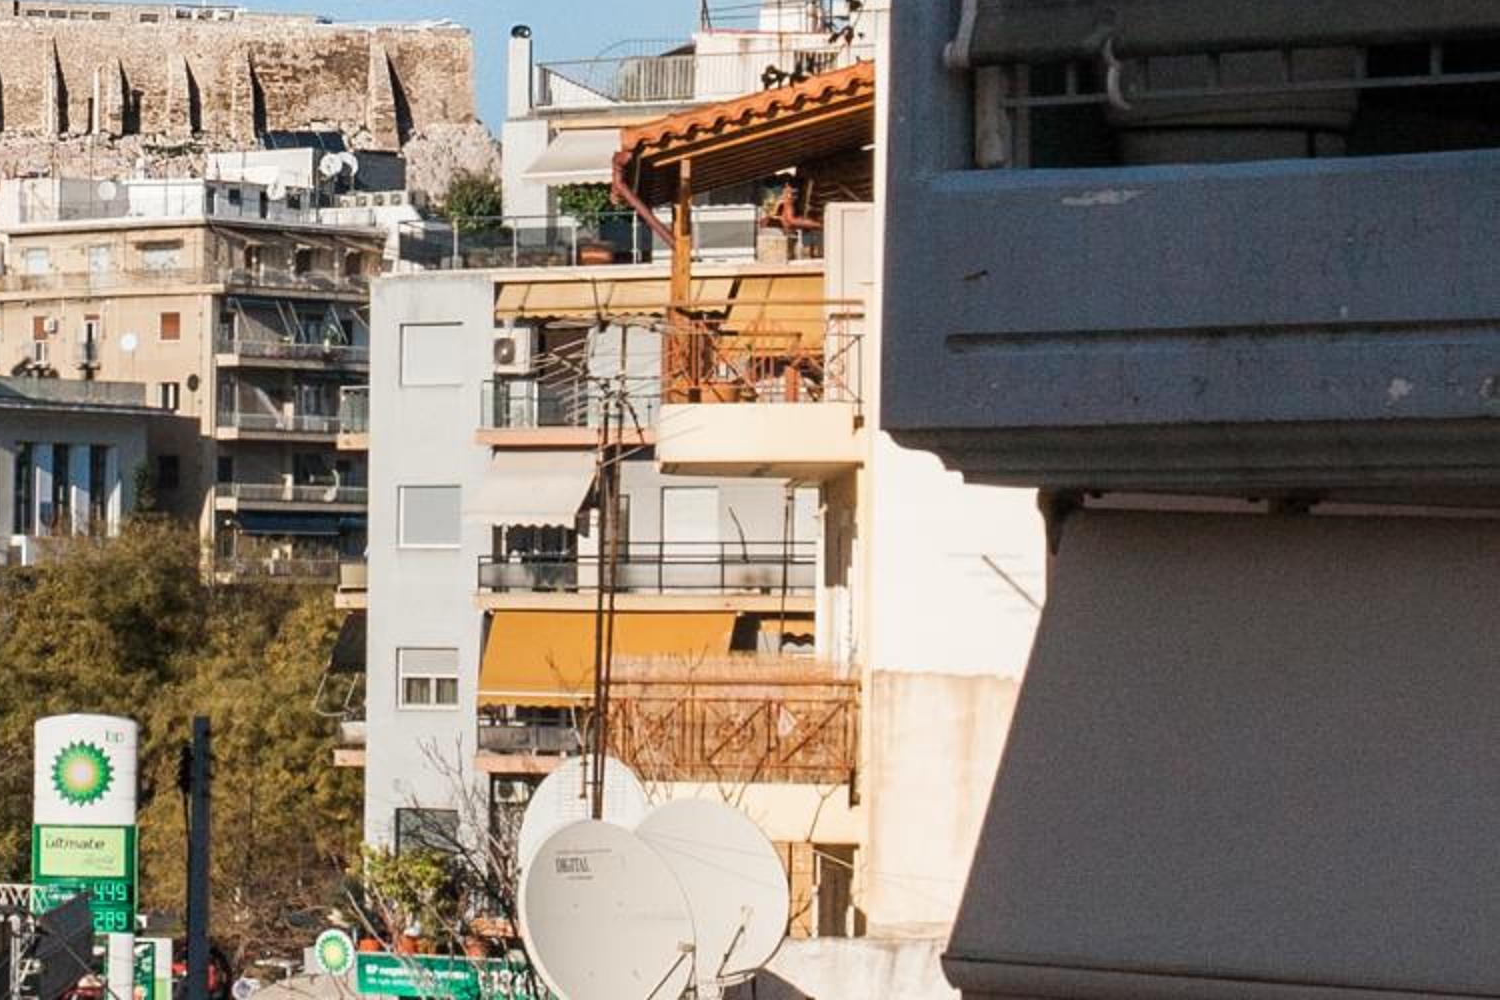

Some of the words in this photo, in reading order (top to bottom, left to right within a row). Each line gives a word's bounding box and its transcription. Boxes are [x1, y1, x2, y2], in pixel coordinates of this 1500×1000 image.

[105, 730, 125, 744] bp
[45, 837, 105, 850] ultimate
[93, 911, 127, 930] 289
